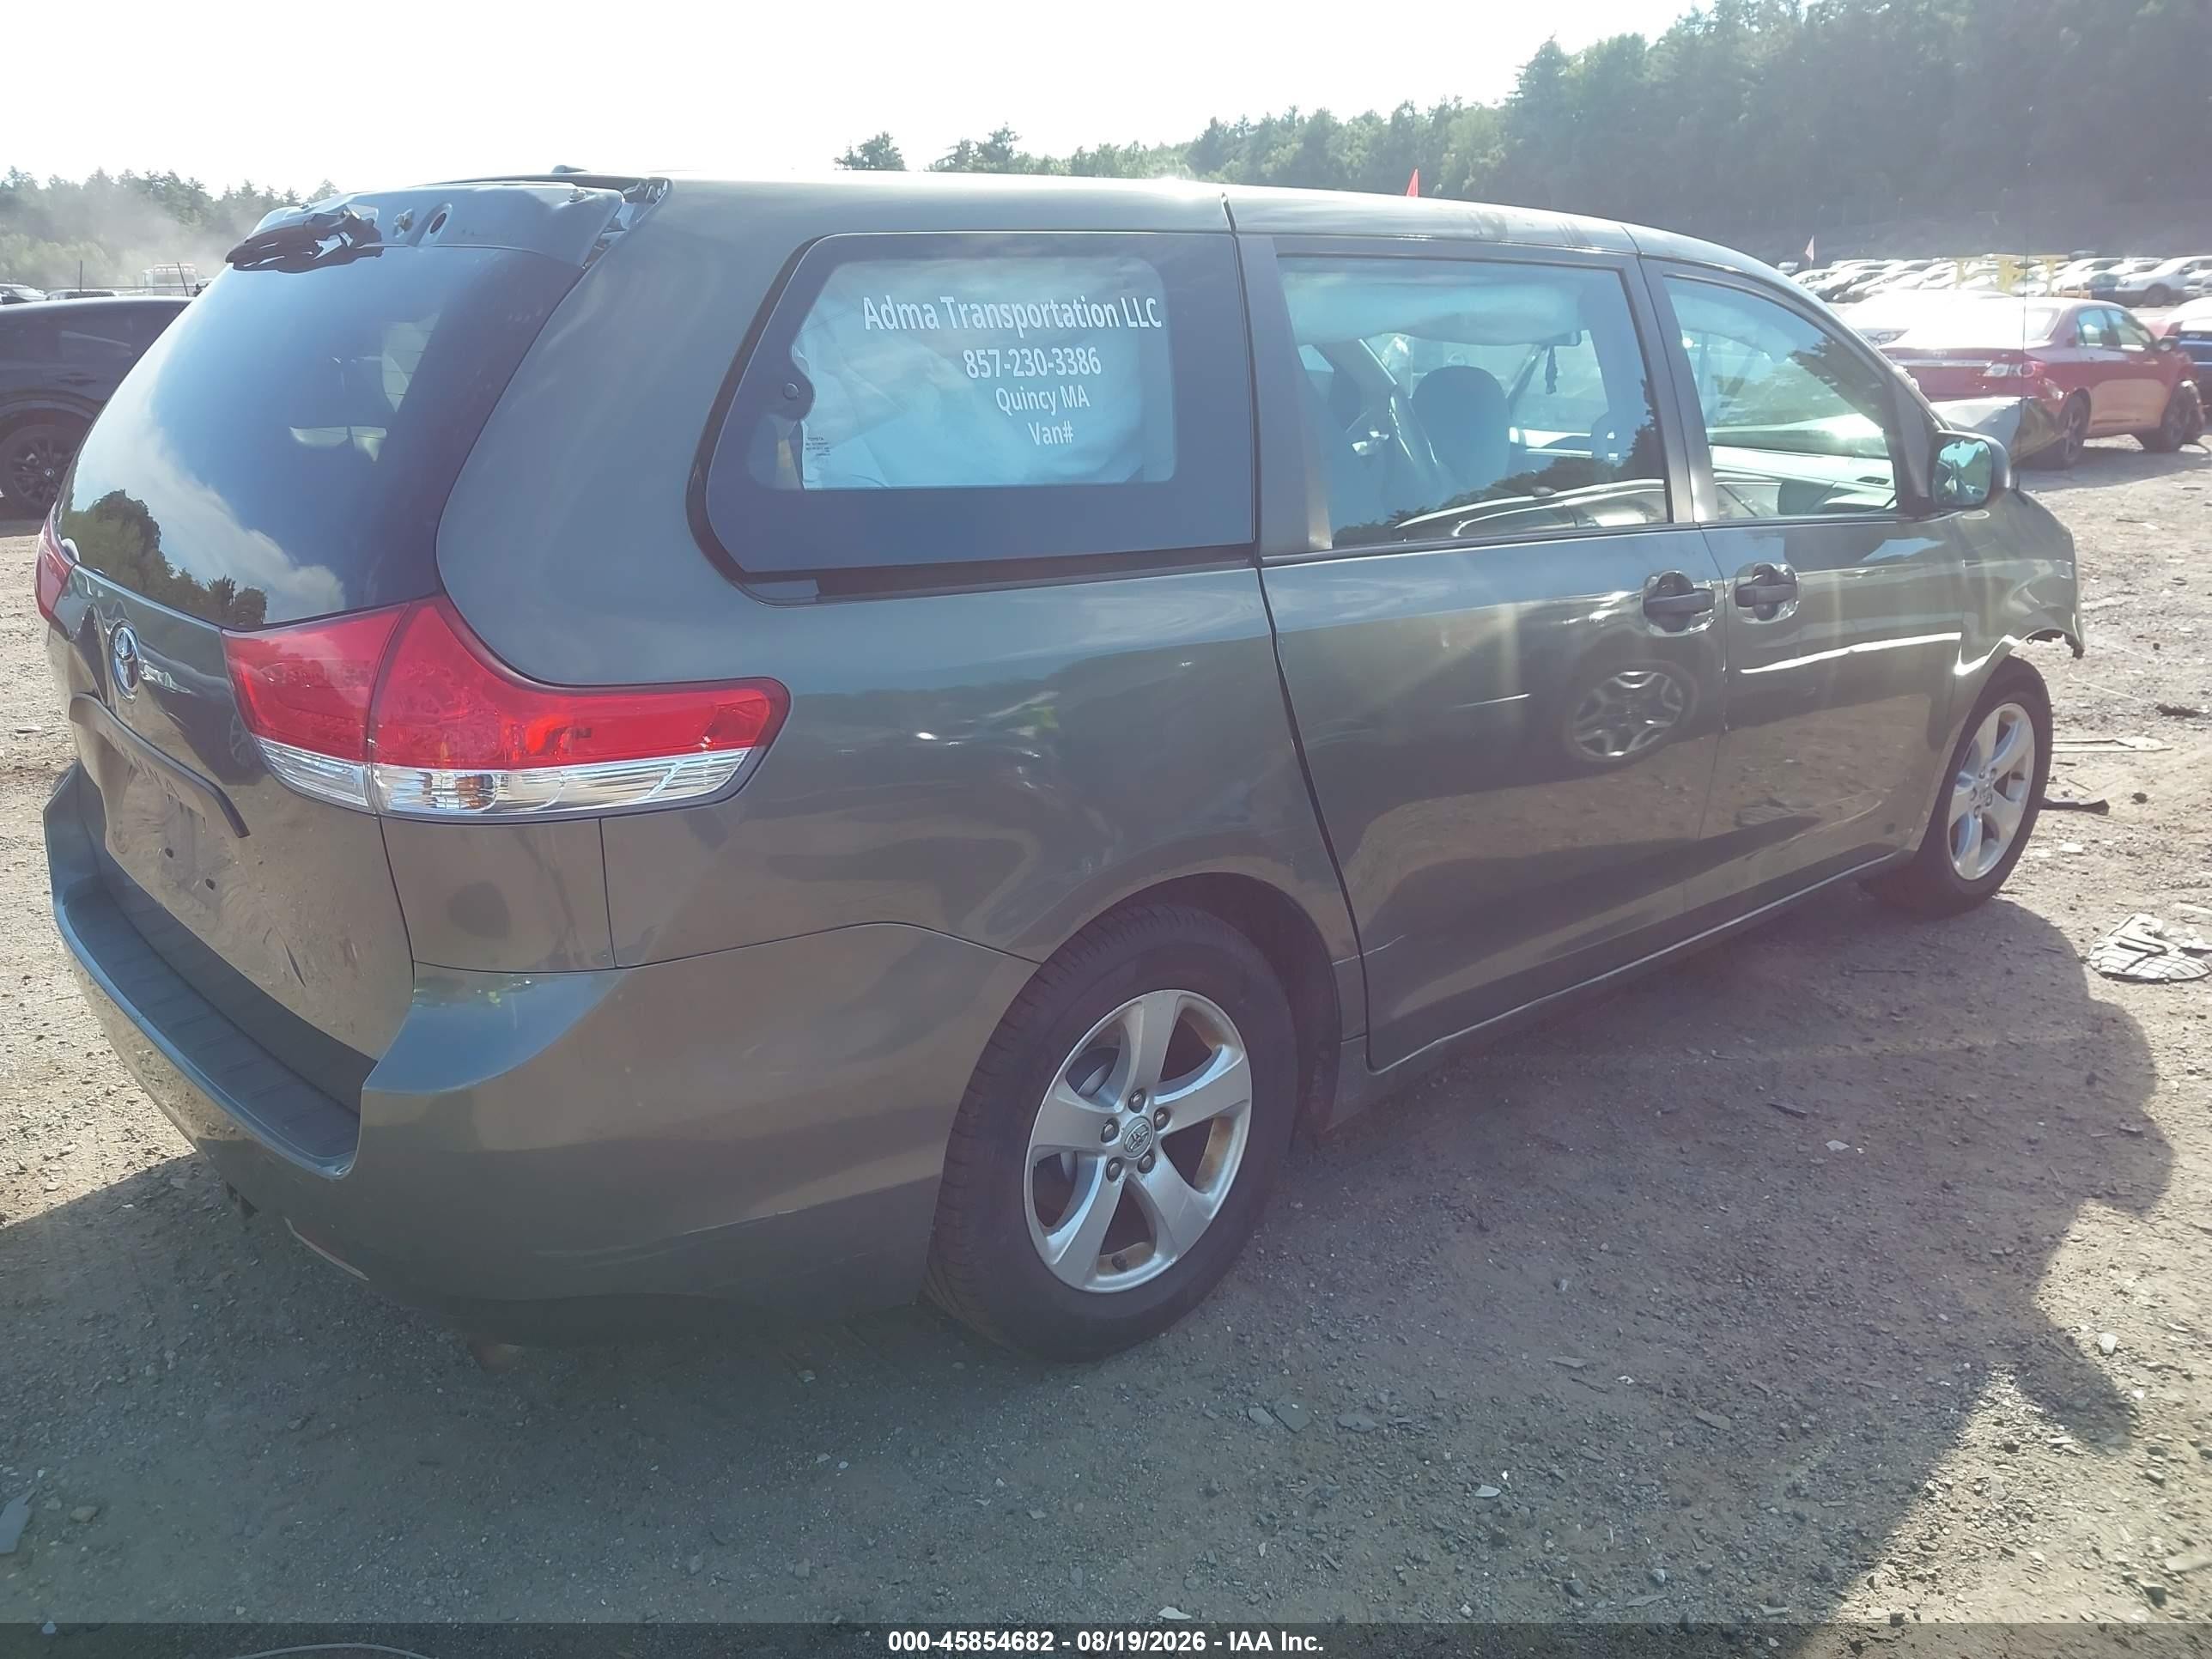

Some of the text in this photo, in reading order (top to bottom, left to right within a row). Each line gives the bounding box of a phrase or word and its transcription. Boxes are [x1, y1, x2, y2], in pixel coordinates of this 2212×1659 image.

[863, 295, 1163, 338] Adma Transportation LLC
[963, 347, 1102, 379] 857-230-3386
[995, 385, 1091, 416] Quincy MA
[1028, 420, 1074, 447] Van#
